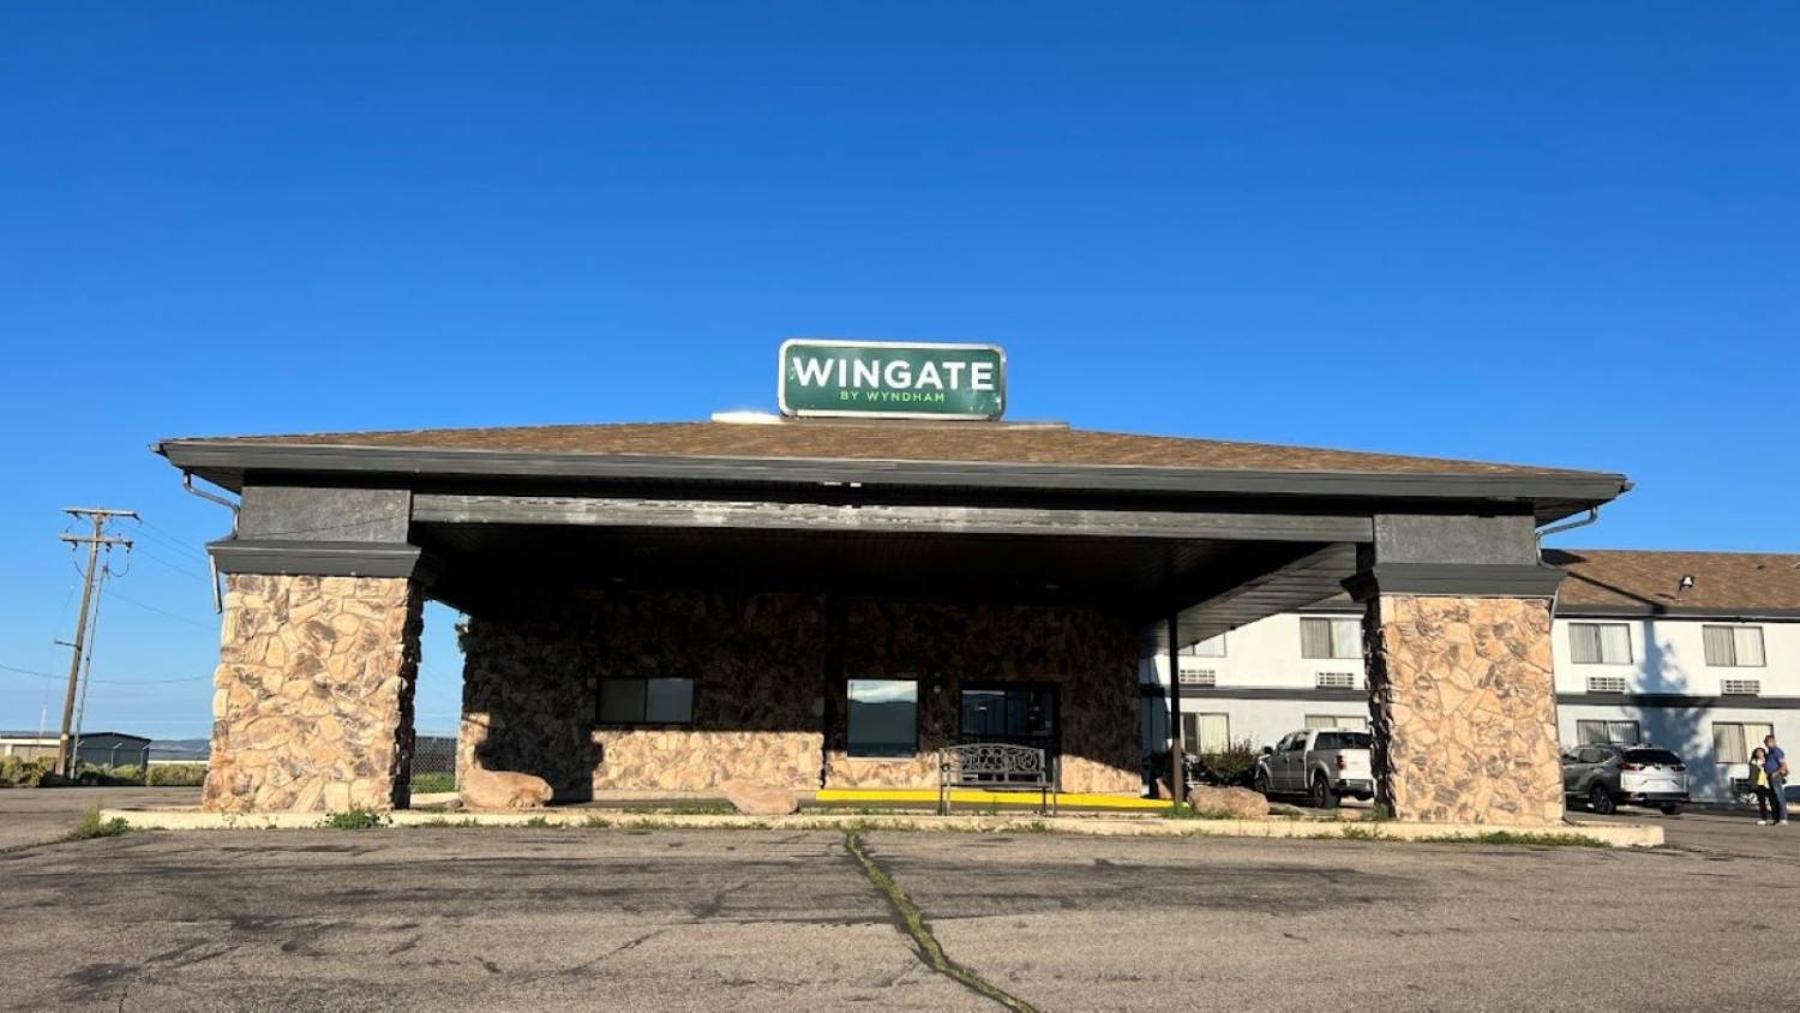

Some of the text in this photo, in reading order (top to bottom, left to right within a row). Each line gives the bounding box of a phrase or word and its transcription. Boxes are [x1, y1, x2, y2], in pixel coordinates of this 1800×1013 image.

[793, 357, 994, 390] WINGATE
[840, 390, 945, 402] BY WYNDHAM
